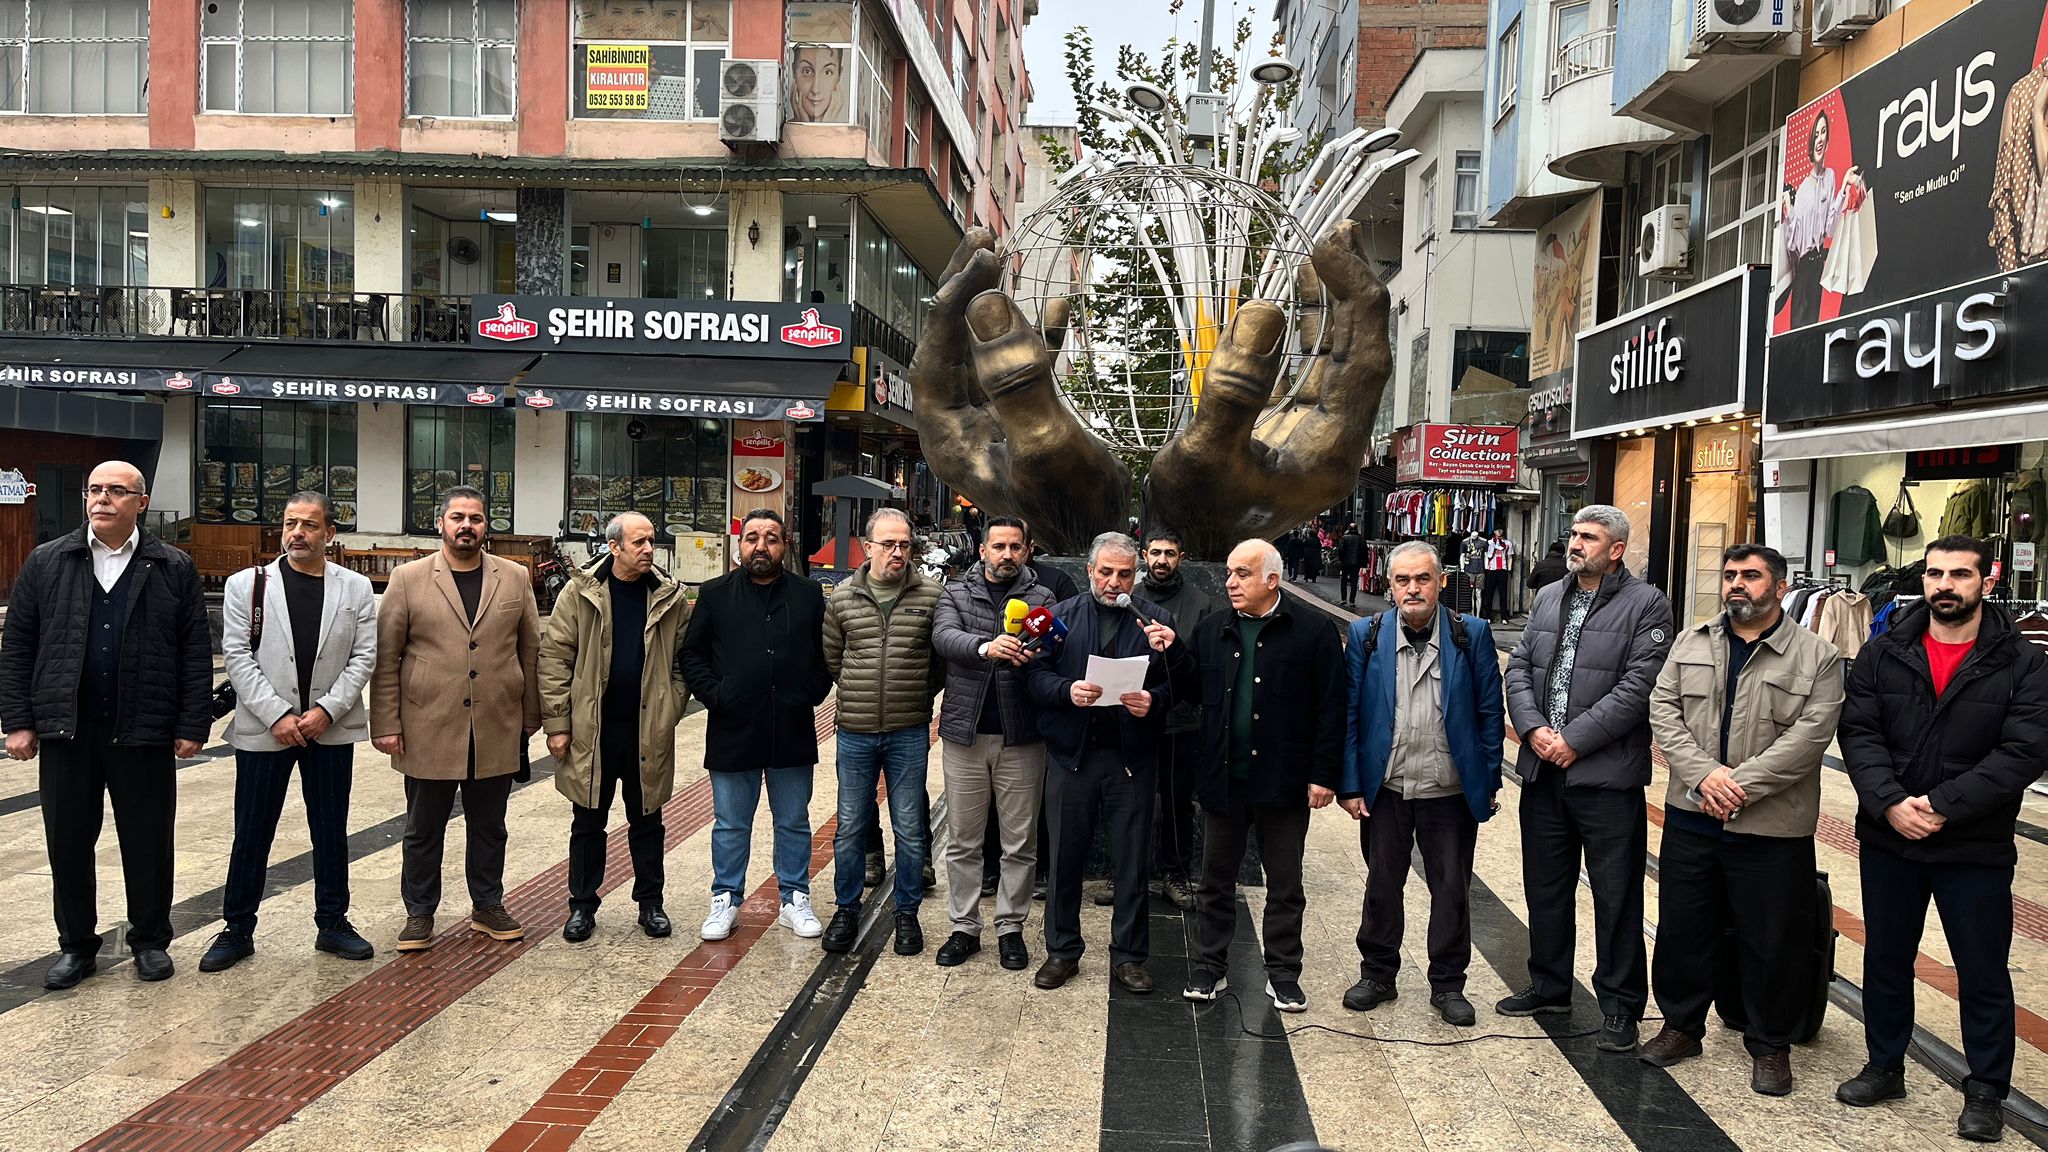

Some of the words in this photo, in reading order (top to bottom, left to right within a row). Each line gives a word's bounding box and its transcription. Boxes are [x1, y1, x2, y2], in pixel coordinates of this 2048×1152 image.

[589, 47, 647, 64] SAHİBİNDEN
[590, 72, 645, 86] KIRALIKTIR
[589, 93, 607, 106] 0532
[609, 93, 623, 106] 553
[624, 94, 634, 106] 58
[636, 94, 646, 106] 85
[1876, 51, 1996, 169] rays
[1915, 183, 1925, 197] de
[1926, 174, 1948, 193] Mutlu
[485, 320, 530, 337] şenpiliç
[547, 301, 635, 345] ŞEHİR
[643, 310, 770, 343] SOFRASI
[787, 327, 834, 343] şenpiliç
[1822, 292, 2004, 389] rays
[1609, 317, 1683, 395] stilife
[50, 369, 137, 385] SOFRASI
[271, 380, 338, 397] ŞEHİR
[344, 384, 437, 400] SOFRASI
[585, 393, 652, 410] ŞEHİR
[658, 398, 754, 415] SOFRASI
[1442, 428, 1500, 449] Şirin
[1429, 447, 1511, 462] Collection
[1696, 438, 1735, 469] stilife
